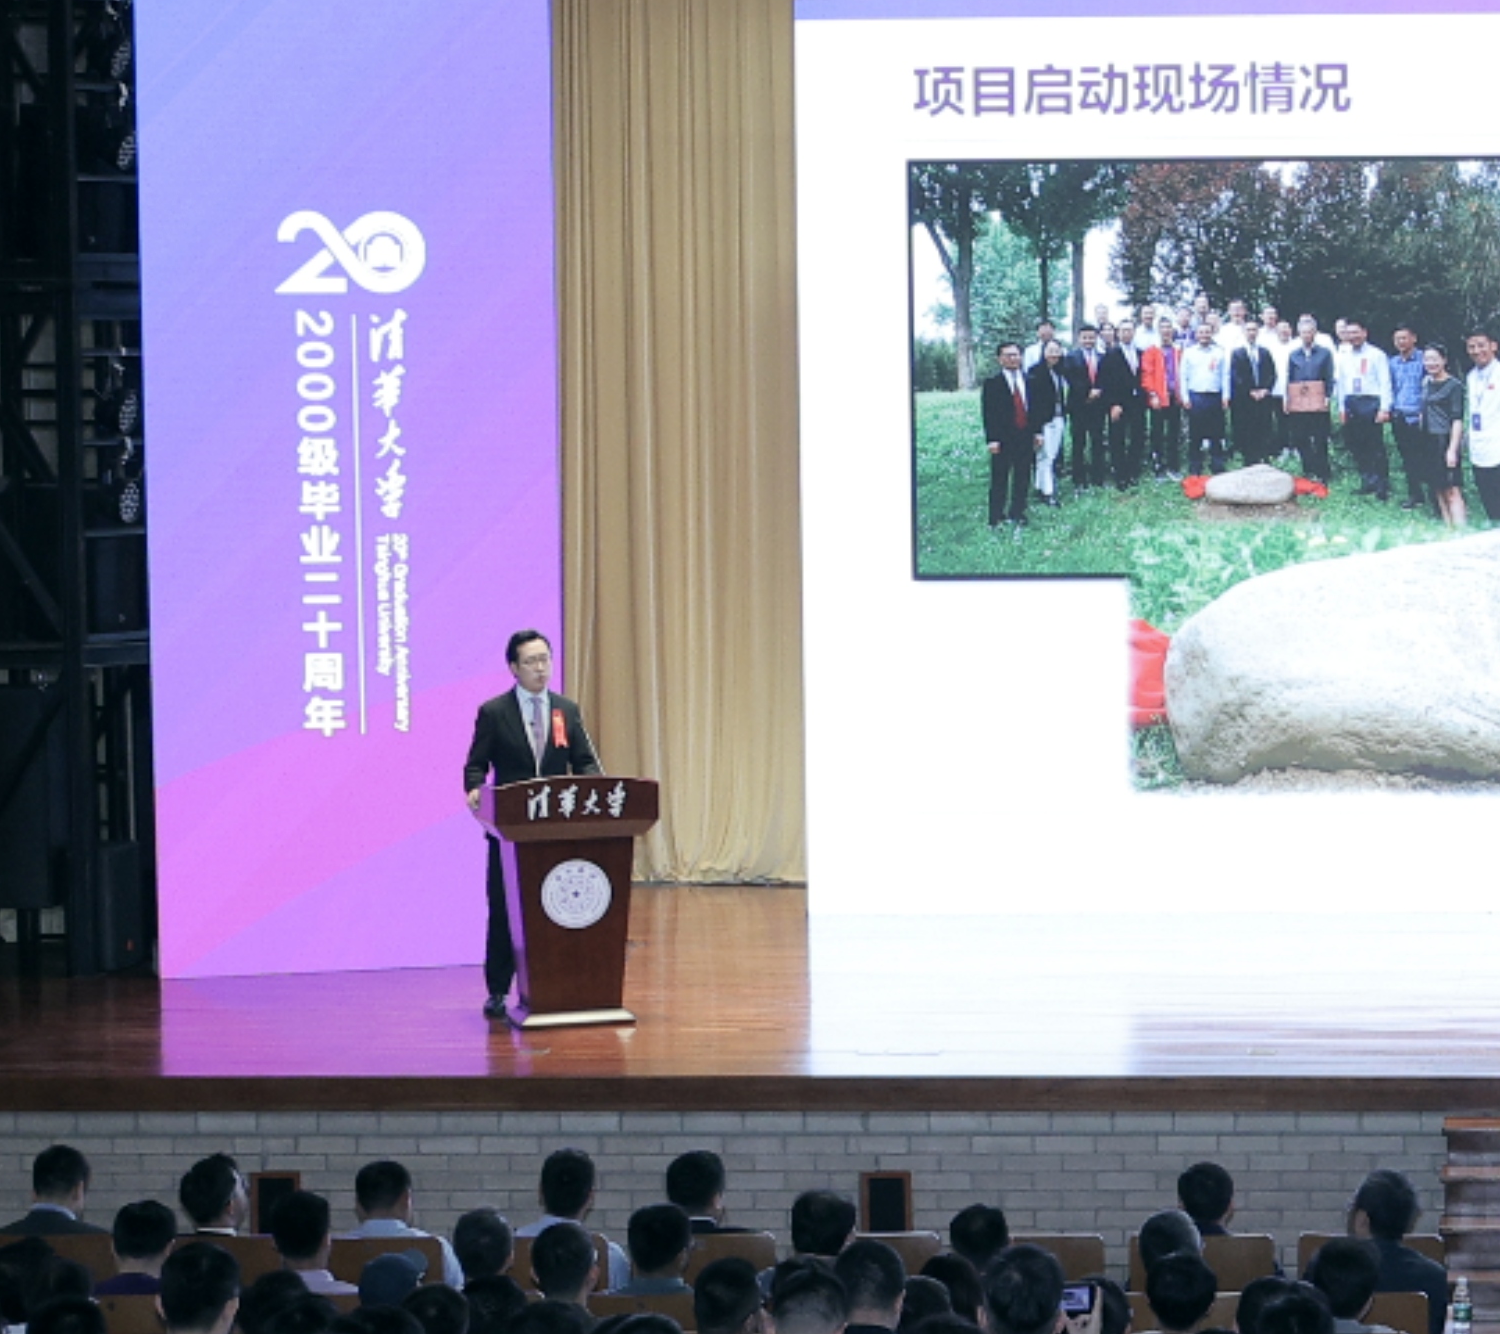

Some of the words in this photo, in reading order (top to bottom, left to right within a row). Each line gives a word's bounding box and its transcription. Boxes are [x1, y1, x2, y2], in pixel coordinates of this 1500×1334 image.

[913, 61, 1352, 118] 项目启动现场情况
[369, 308, 407, 518] 清华大学
[296, 310, 346, 736] 2000级毕业二十周年
[527, 780, 627, 821] 清华大学
